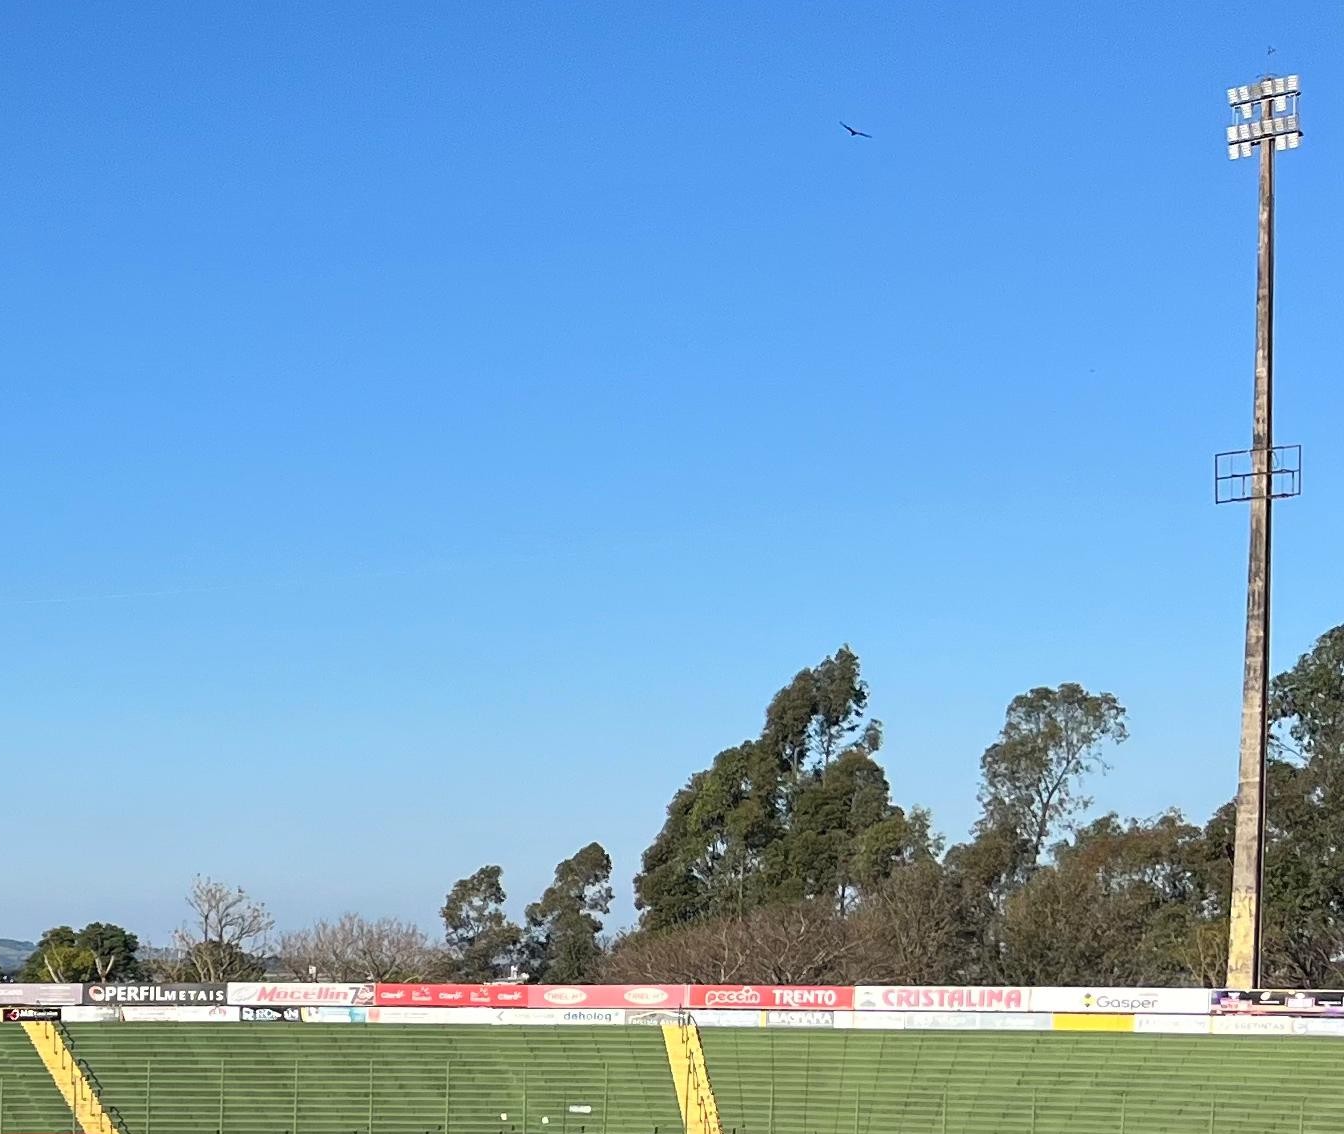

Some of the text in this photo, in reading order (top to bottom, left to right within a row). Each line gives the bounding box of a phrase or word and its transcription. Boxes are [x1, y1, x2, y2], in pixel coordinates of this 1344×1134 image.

[104, 986, 165, 1001] PERFIL
[772, 989, 837, 1006] TRENTO
[882, 988, 1022, 1008] CRISTALINA
[1096, 996, 1159, 1010] Gasper
